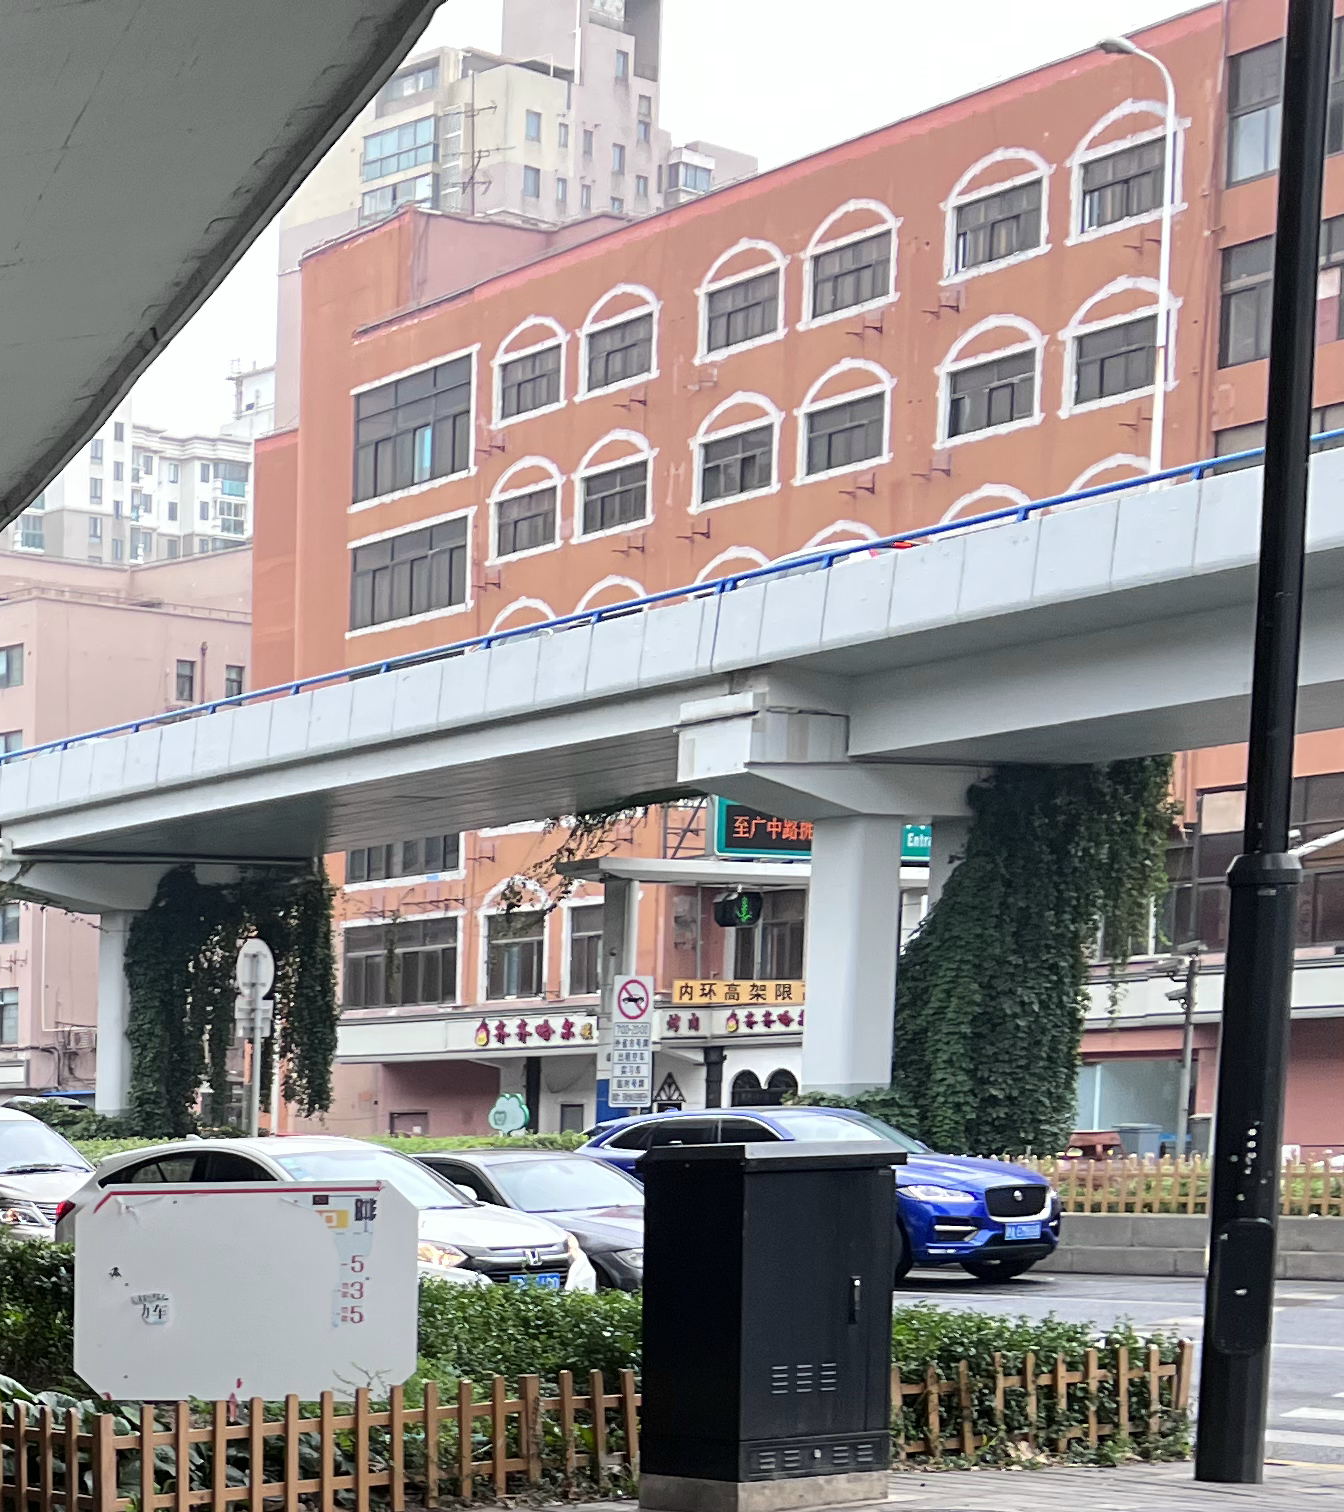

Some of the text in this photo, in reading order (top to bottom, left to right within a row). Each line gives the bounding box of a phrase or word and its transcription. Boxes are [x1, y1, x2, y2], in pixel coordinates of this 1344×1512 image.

[678, 982, 806, 1001] 内环高架限
